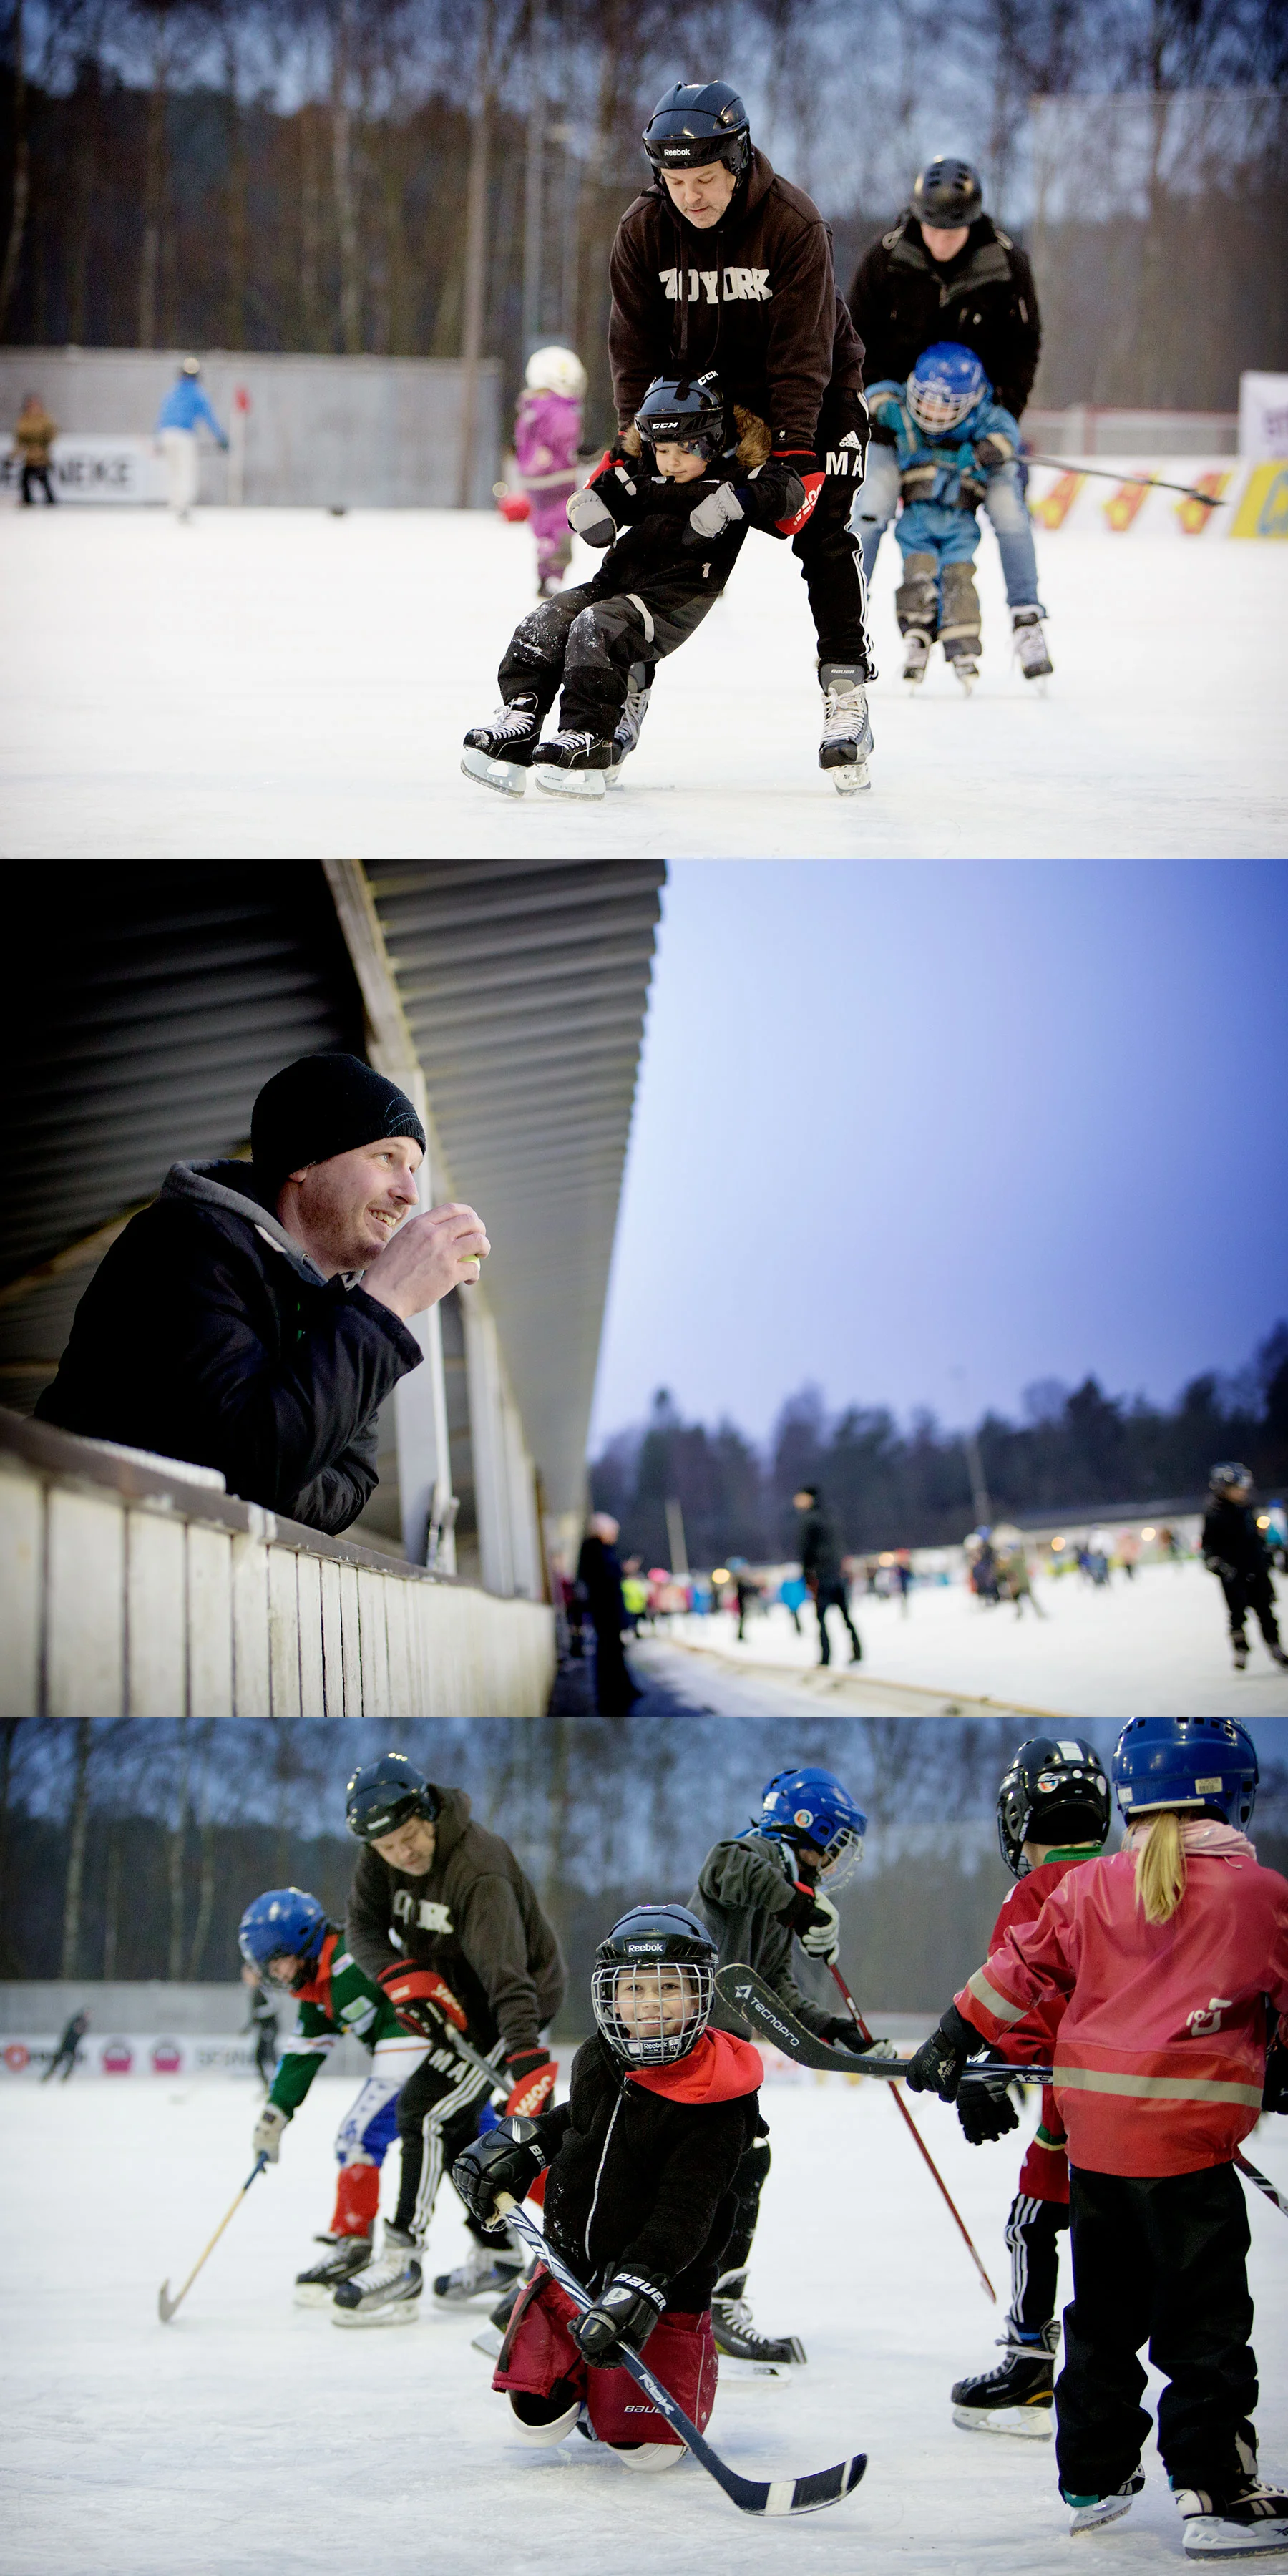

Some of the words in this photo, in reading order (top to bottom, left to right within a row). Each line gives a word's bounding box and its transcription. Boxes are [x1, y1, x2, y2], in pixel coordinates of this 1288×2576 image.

[664, 148, 691, 157] Reebok
[628, 1943, 663, 1952] Reebok
[613, 2273, 667, 2312] BAUER
